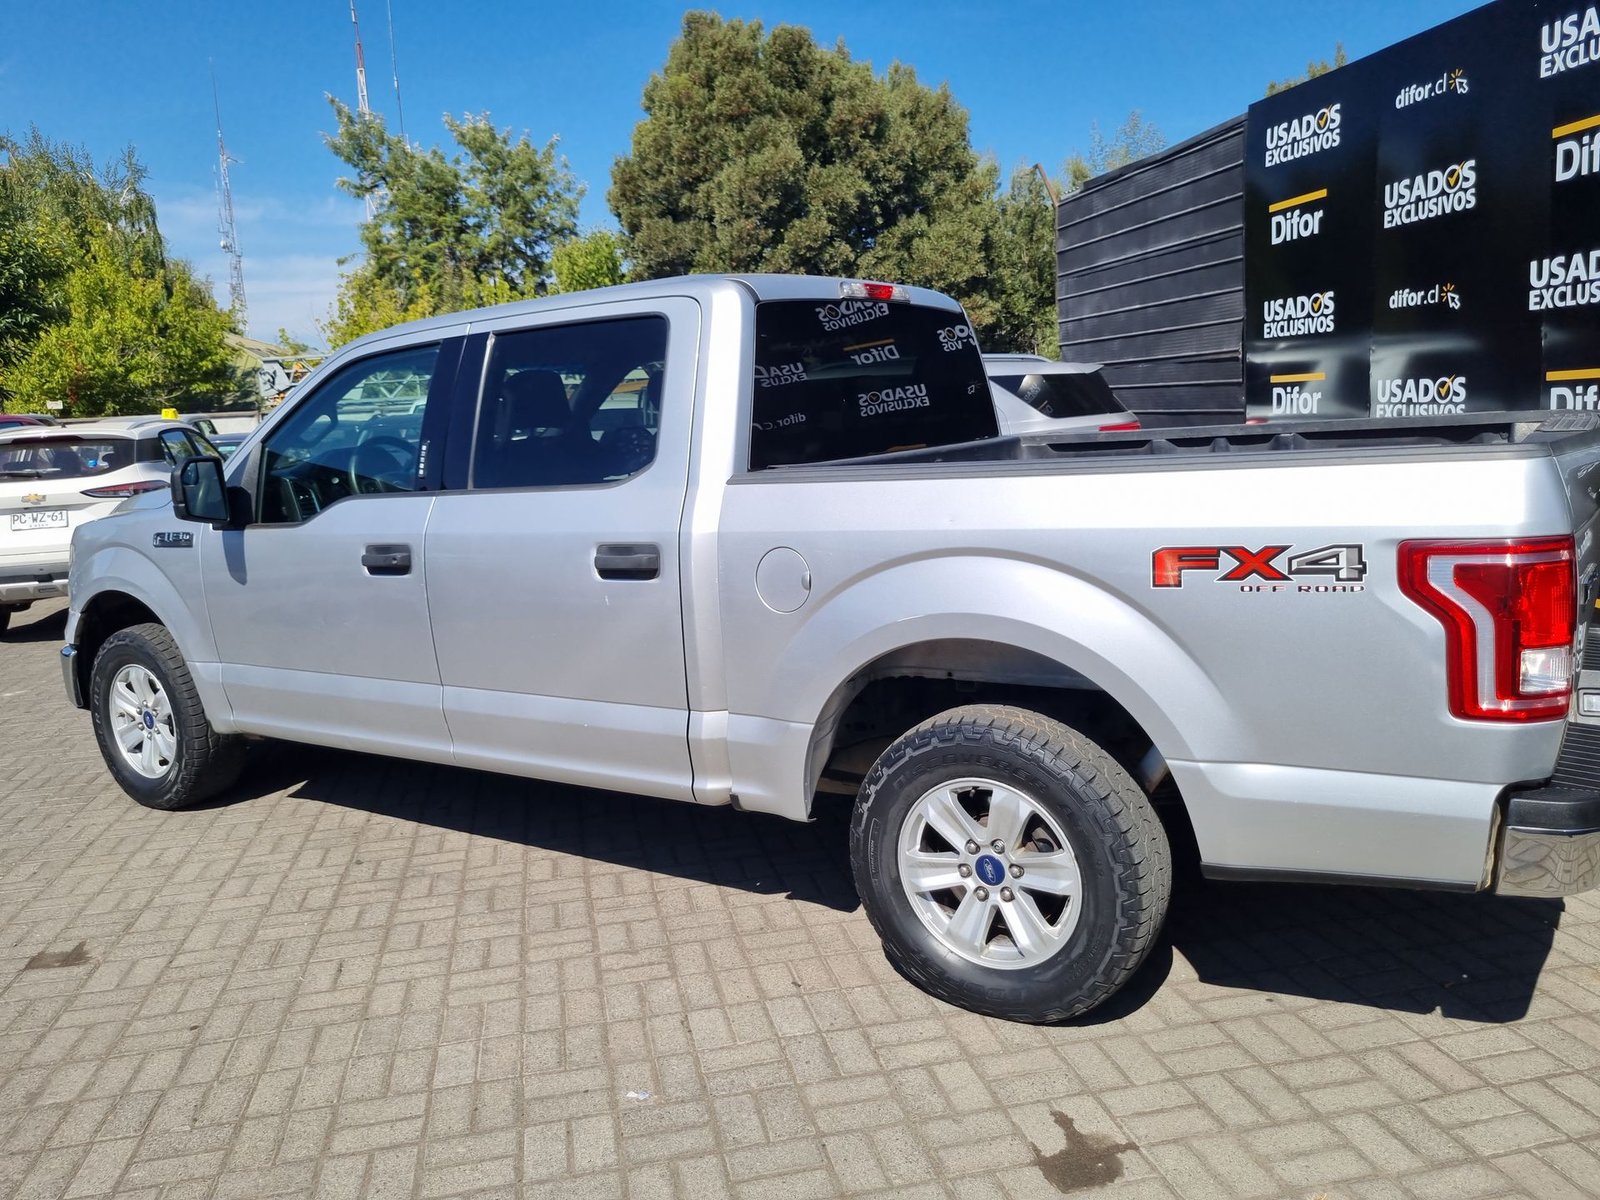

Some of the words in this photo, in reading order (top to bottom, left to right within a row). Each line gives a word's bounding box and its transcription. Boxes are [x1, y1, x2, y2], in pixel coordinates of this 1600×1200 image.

[1541, 7, 1600, 53] USA
[1395, 72, 1447, 109] difor.cl
[1266, 103, 1341, 149] USADOS
[1265, 128, 1341, 167] EXCLUSIVOS
[1383, 160, 1477, 208] USADOS
[1383, 187, 1476, 229] EXCLUSIVOS
[1271, 209, 1323, 245] Difor
[1263, 291, 1335, 322] USADOS
[1389, 284, 1439, 309] difor.cl
[1263, 313, 1335, 339] EXCLUSIVOS
[1272, 386, 1322, 414] Difor
[1377, 374, 1467, 404] USADOS
[1551, 385, 1600, 411] Dif
[1151, 544, 1367, 588] FX4
[1240, 585, 1287, 593] OFF
[1297, 585, 1366, 593] ROAD
